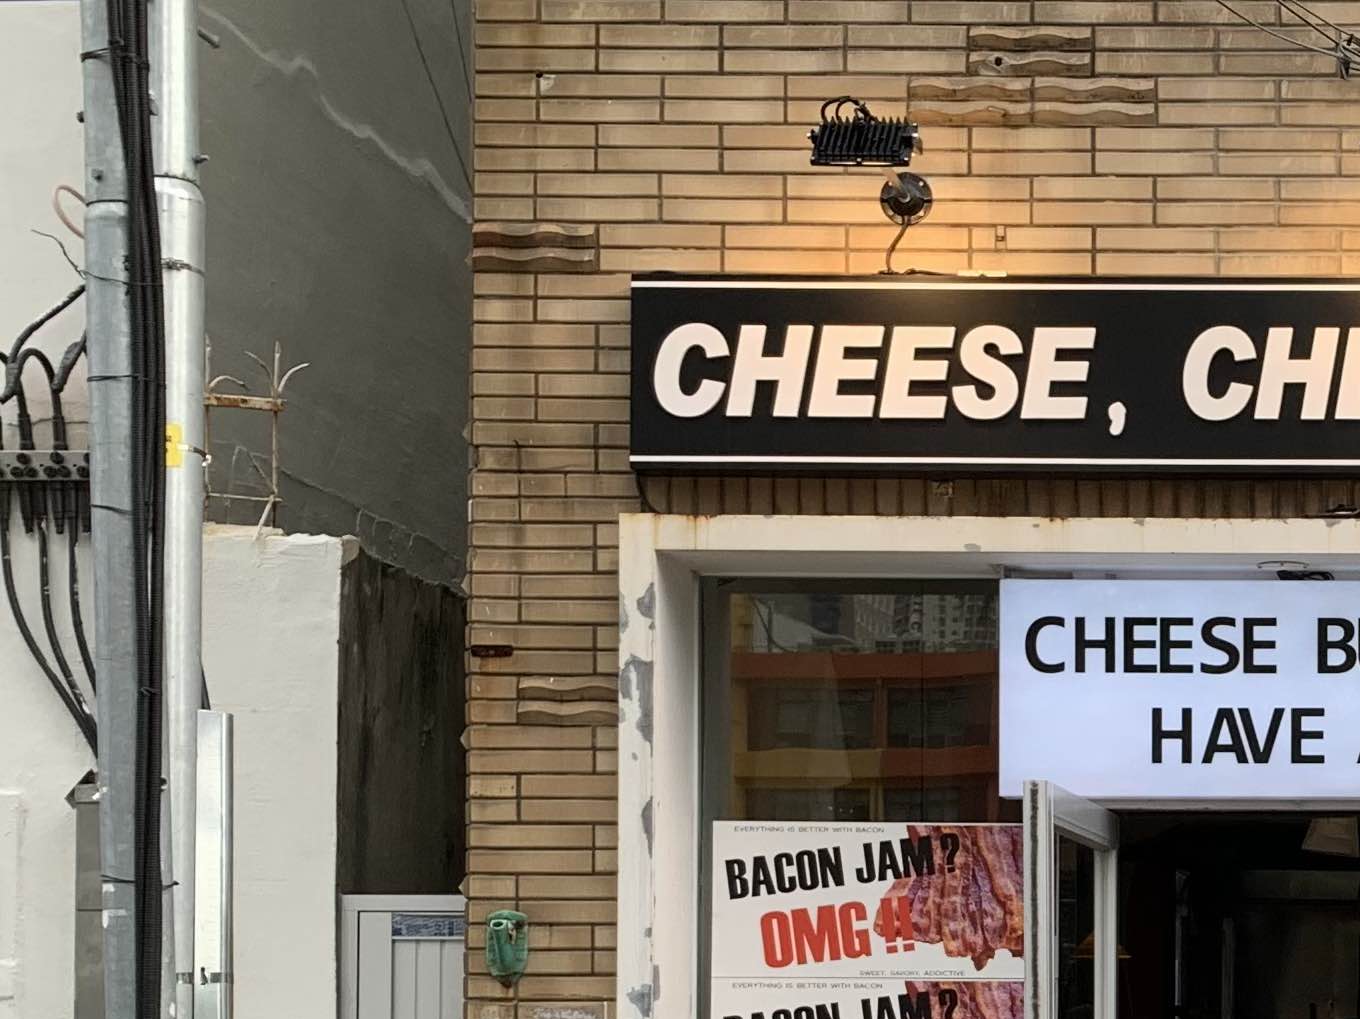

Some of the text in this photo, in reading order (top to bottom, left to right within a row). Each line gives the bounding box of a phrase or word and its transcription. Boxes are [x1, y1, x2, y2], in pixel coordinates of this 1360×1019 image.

[653, 322, 1127, 436] CHEESE,
[1024, 615, 1278, 675] CHEESE
[1151, 707, 1325, 764] HAVE
[725, 833, 960, 900] BACON JAM?
